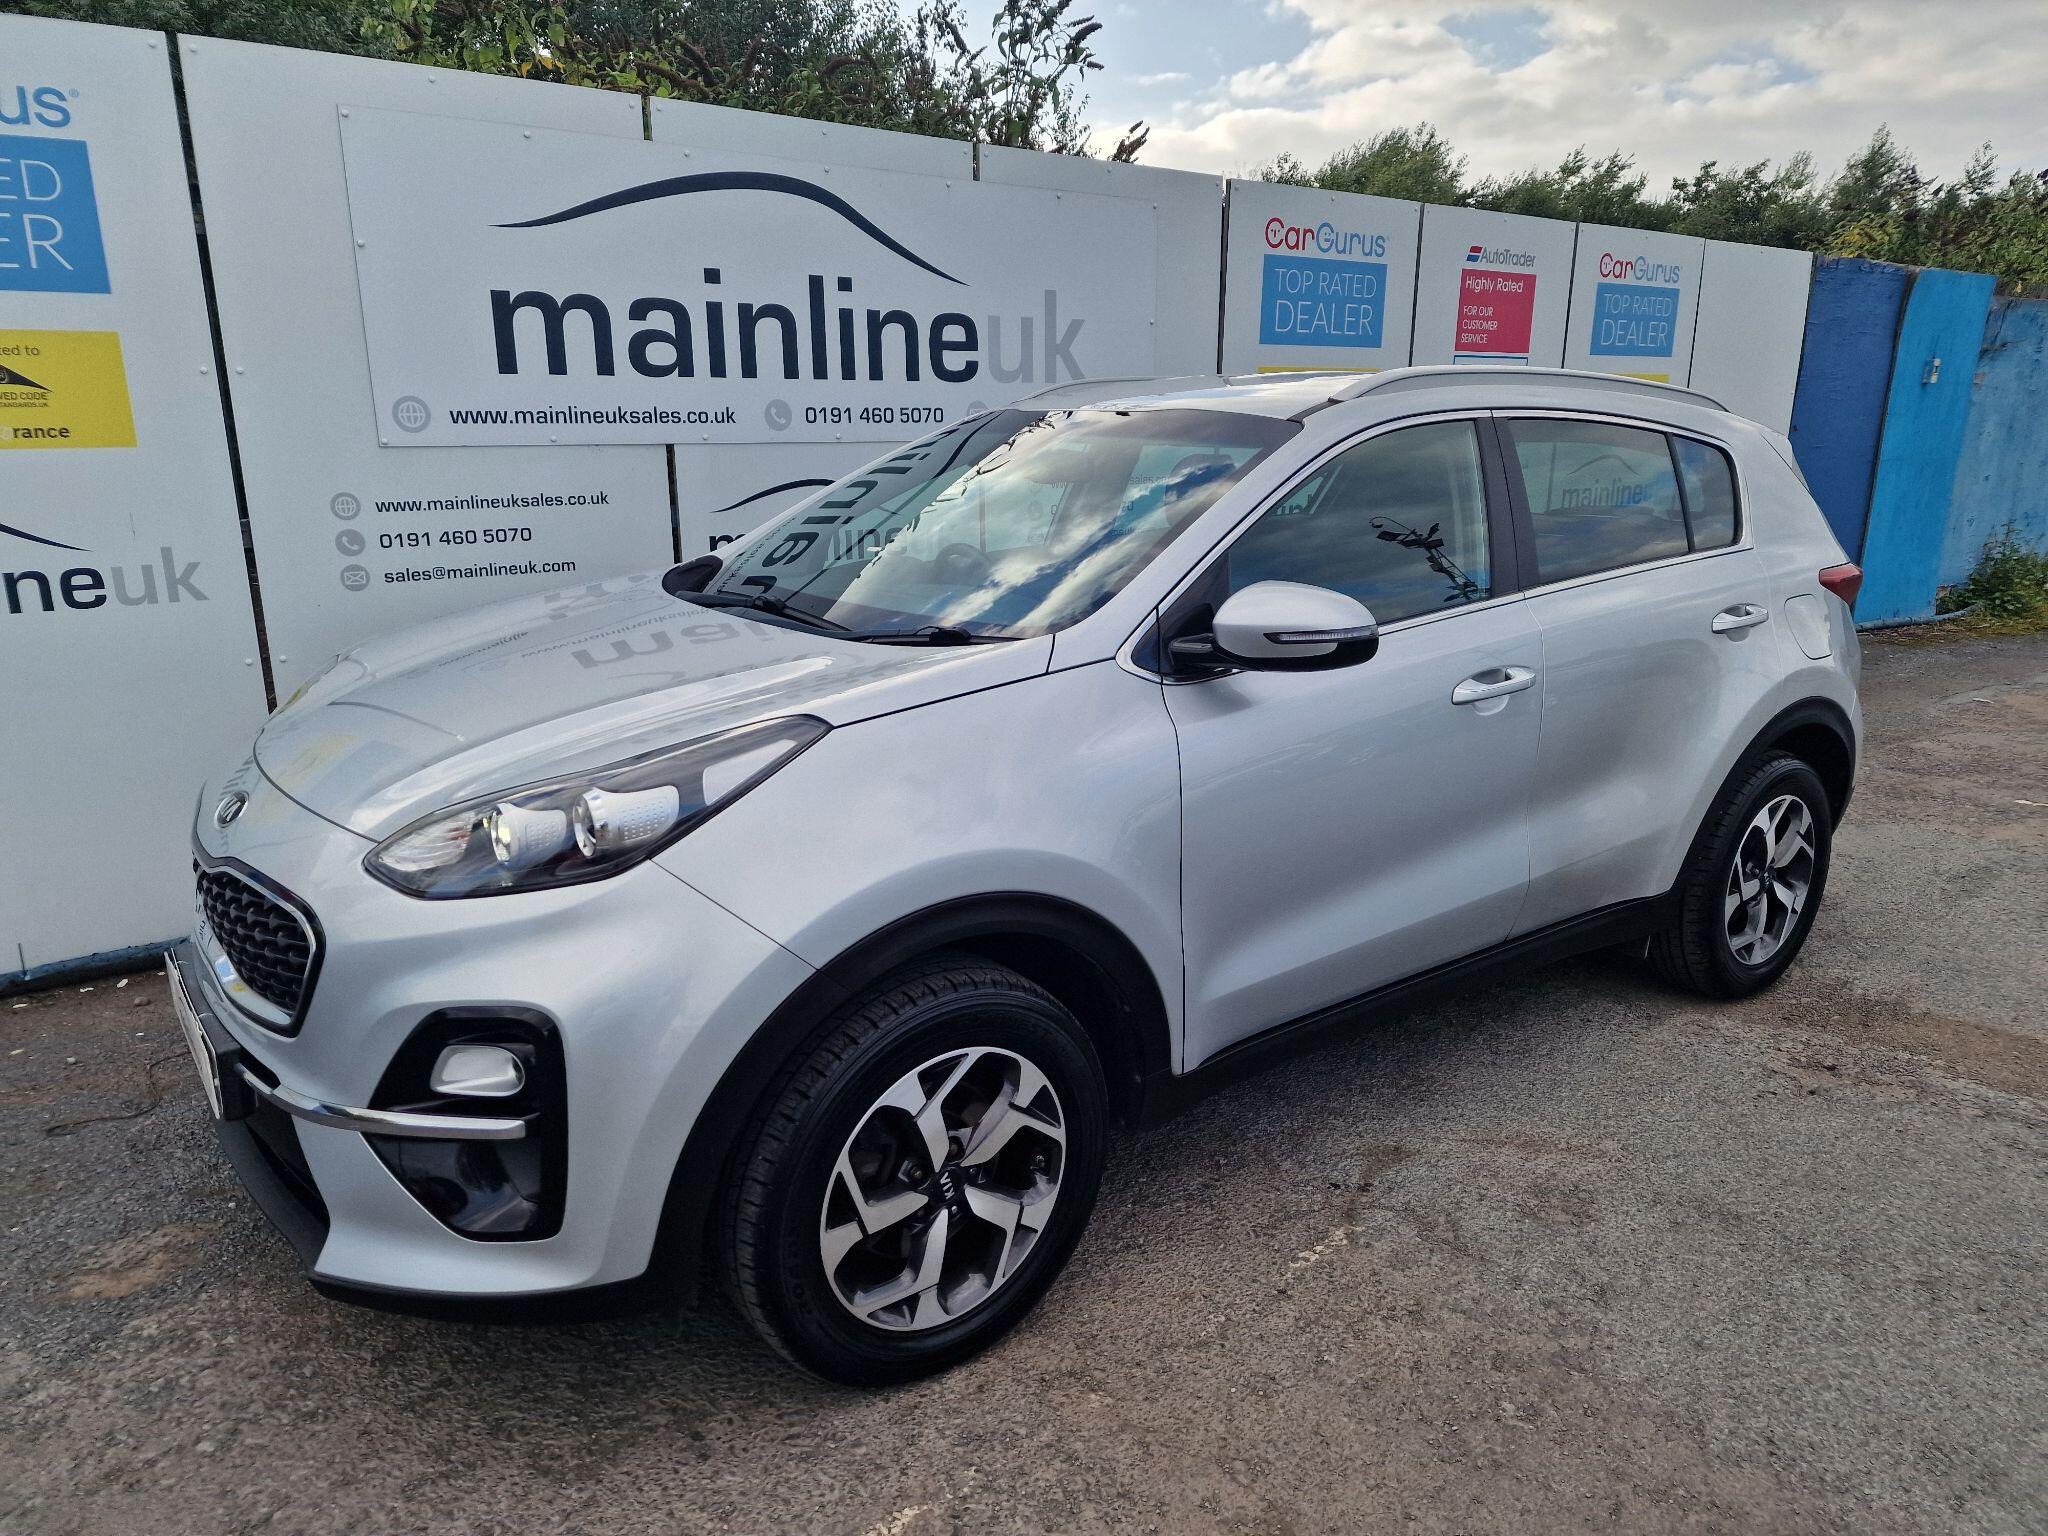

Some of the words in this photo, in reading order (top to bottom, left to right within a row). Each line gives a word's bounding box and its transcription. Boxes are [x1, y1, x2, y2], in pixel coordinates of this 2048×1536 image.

[1265, 217, 1386, 258] CarGurus
[1480, 247, 1536, 268] AutoTrader
[1600, 253, 1680, 284] CarGurus
[1274, 268, 1314, 294] TOP
[1319, 272, 1377, 298] RATED
[1466, 276, 1495, 293] Highly
[1497, 278, 1523, 293] Rated
[1463, 305, 1478, 316] FOR
[1478, 306, 1493, 317] OUR
[1604, 293, 1631, 314] TOP
[1632, 295, 1673, 317] RATED
[489, 268, 1086, 384] mainlineuk
[1275, 300, 1373, 335] DEALER
[1462, 320, 1498, 331] CUSTOMER
[1460, 333, 1488, 344] SERVICE
[1601, 319, 1669, 347] DEALER
[25, 345, 40, 356] to
[20, 391, 48, 401] CODE
[449, 405, 737, 425] www.mainlineuksales.co.uk
[804, 406, 853, 424] 0191
[859, 406, 895, 424] 460
[899, 407, 944, 424] 5070
[13, 427, 71, 439] rance
[375, 491, 610, 513] www.mainlineuksales.co.uk
[379, 531, 432, 549] 0191
[438, 530, 478, 546] 460
[482, 527, 532, 545] 5070
[1, 546, 210, 614] neuk
[384, 561, 576, 584] sales@mainlineuk.com
